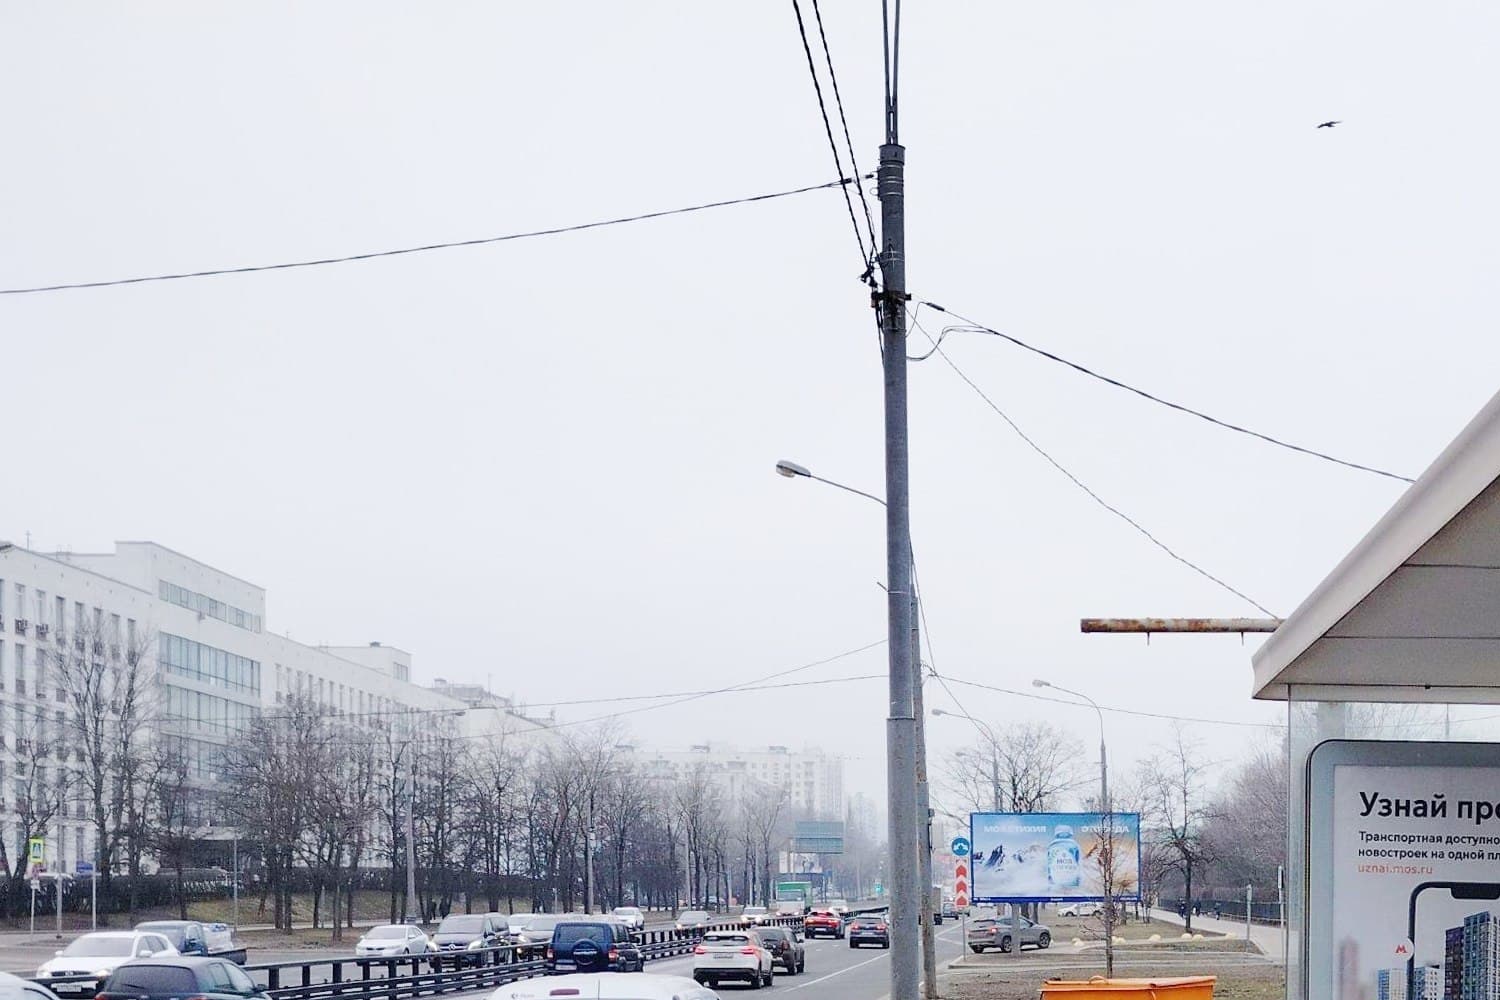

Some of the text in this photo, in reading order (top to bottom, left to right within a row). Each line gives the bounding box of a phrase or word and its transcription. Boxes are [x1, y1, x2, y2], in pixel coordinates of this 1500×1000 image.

[1359, 791, 1447, 818] Узнай
[1358, 831, 1442, 845] Транспортная
[1358, 848, 1428, 859] новостроек
[1431, 851, 1445, 860] на
[1448, 849, 1485, 862] одной
[1358, 862, 1433, 875] uznai.mos.ru
